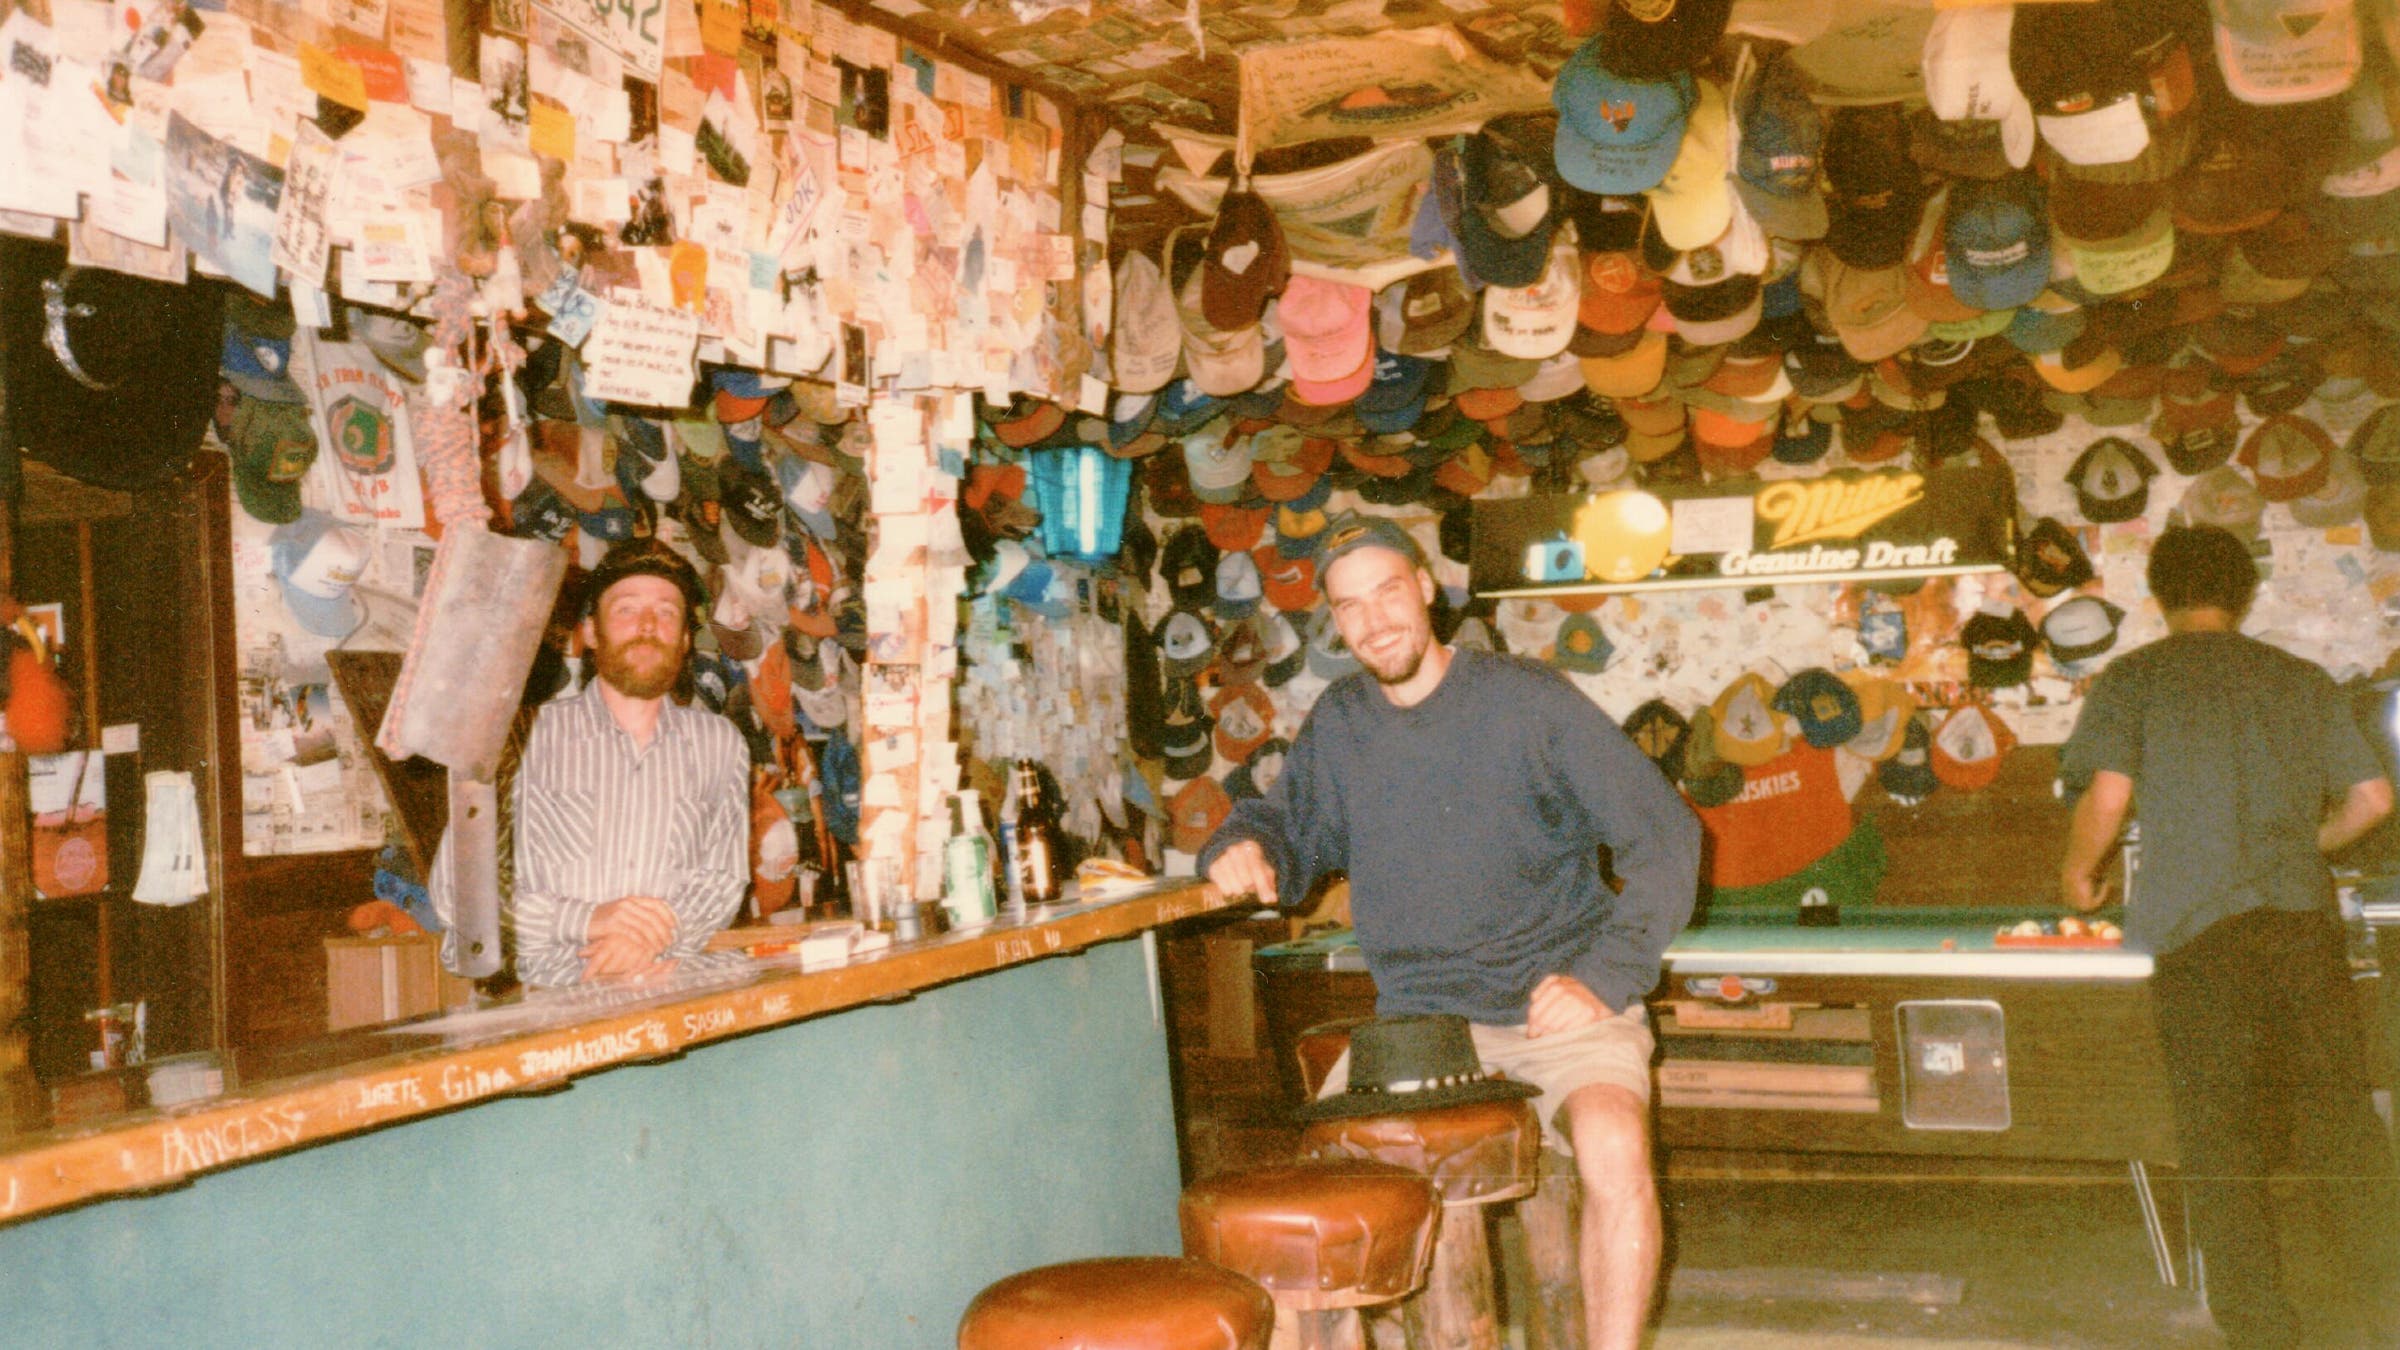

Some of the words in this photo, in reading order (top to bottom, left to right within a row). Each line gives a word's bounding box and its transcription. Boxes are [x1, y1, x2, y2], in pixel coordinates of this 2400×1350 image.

[1757, 473, 1924, 549] Miller
[1720, 545, 1859, 575] Genuine
[1864, 537, 1957, 568] Draft
[1729, 771, 1801, 804] USKIES
